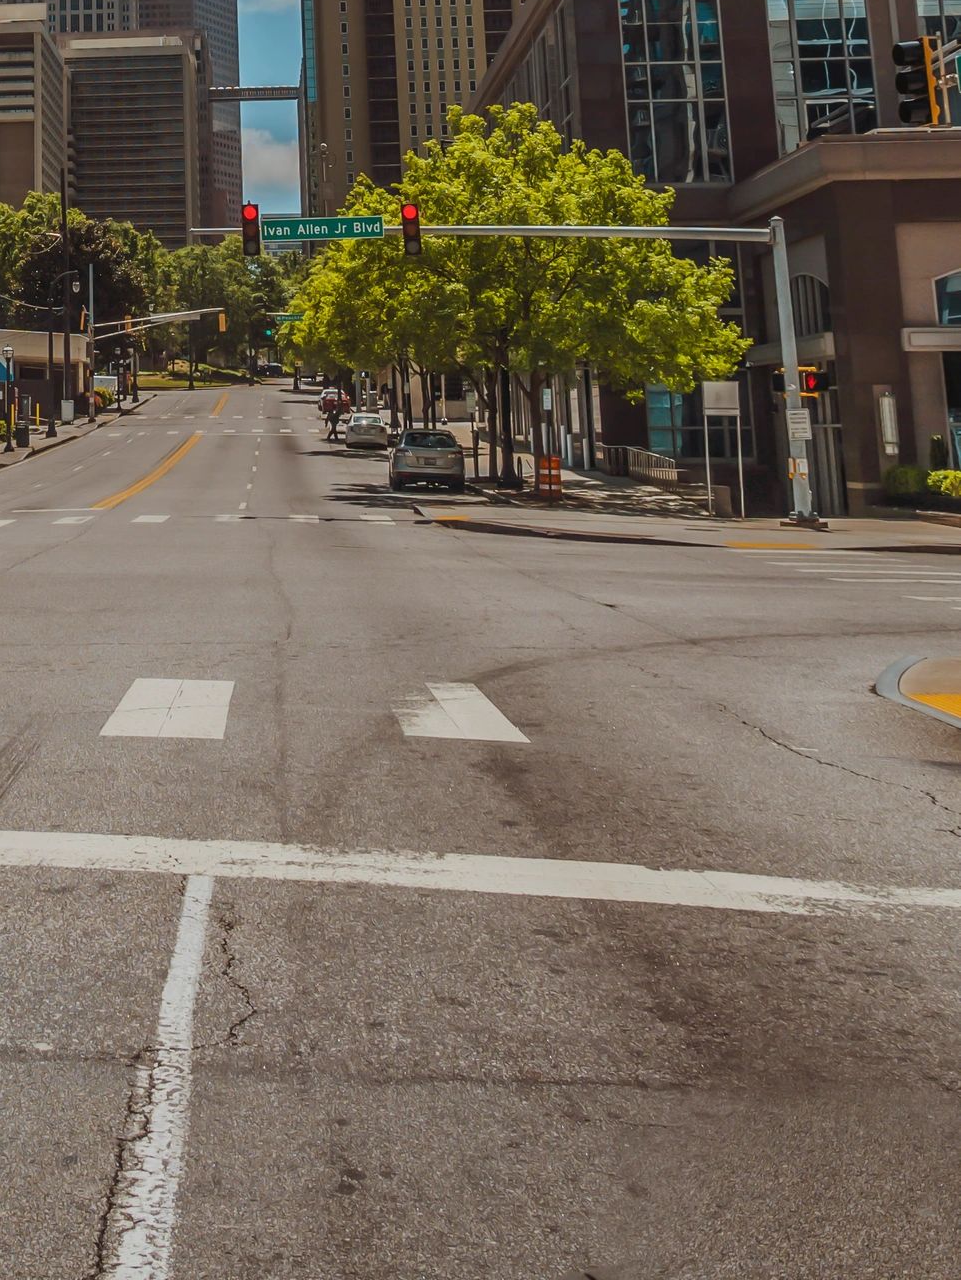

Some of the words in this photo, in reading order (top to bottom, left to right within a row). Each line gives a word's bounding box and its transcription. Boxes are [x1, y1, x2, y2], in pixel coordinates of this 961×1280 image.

[264, 225, 290, 236] Ivan
[297, 224, 328, 235] Allen
[334, 223, 347, 234] Jr
[353, 222, 380, 233] Blvd
